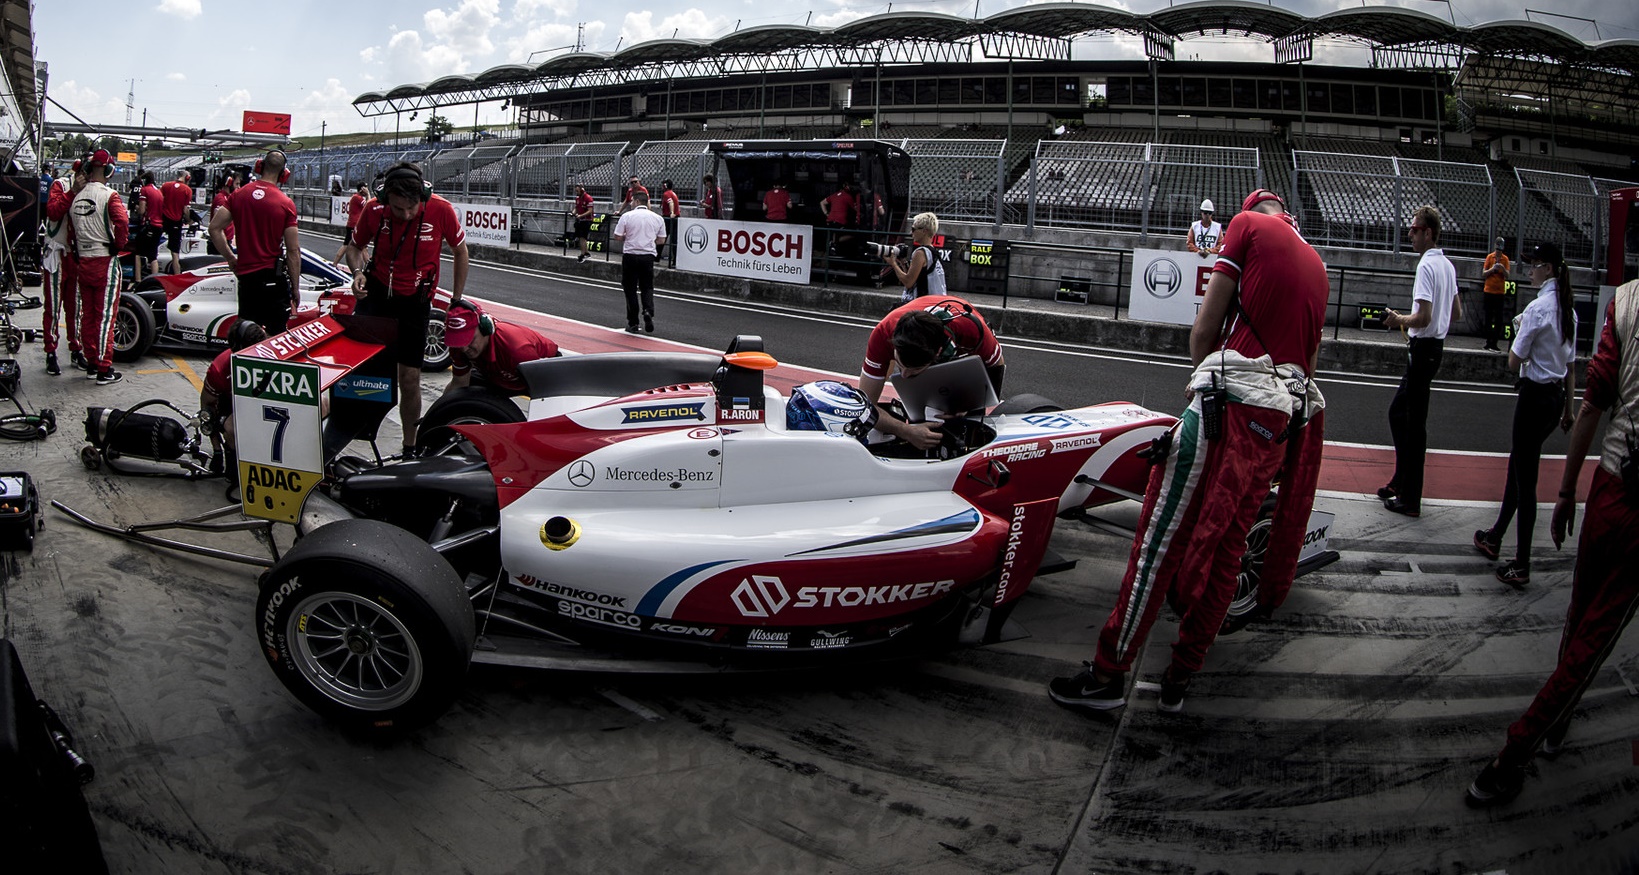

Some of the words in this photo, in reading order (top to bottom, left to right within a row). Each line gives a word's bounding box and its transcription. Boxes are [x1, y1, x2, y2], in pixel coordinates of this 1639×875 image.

[465, 210, 507, 230] BOSCH
[465, 230, 482, 238] Technik
[492, 233, 507, 241] Leben
[717, 229, 804, 259] BOSCH
[971, 245, 992, 253] RALF
[717, 257, 751, 270] Technik
[752, 261, 771, 272] fürs
[773, 262, 802, 275] Leben
[970, 254, 992, 265] BOX
[1504, 281, 1516, 295] P3
[269, 321, 332, 356] STOKKER
[1504, 326, 1510, 339] 5
[352, 379, 390, 390] ultimate
[629, 407, 698, 420] RAVENOL
[721, 409, 760, 420] R.ARON
[262, 405, 290, 463] 7
[1250, 421, 1273, 440] sparco
[982, 442, 1039, 458] THEODORE
[1056, 437, 1097, 450] RAVENOL
[1006, 448, 1046, 462] RACING
[248, 465, 302, 493] ADAC
[605, 467, 714, 482] Mercedes-Benz
[995, 506, 1025, 604] stokker.com
[793, 579, 955, 608] STOKKER
[558, 600, 642, 627] sparco
[299, 614, 307, 632] ATS
[650, 622, 716, 636] KONI
[748, 629, 789, 641] Nissens
[810, 637, 850, 646] GULLWING
